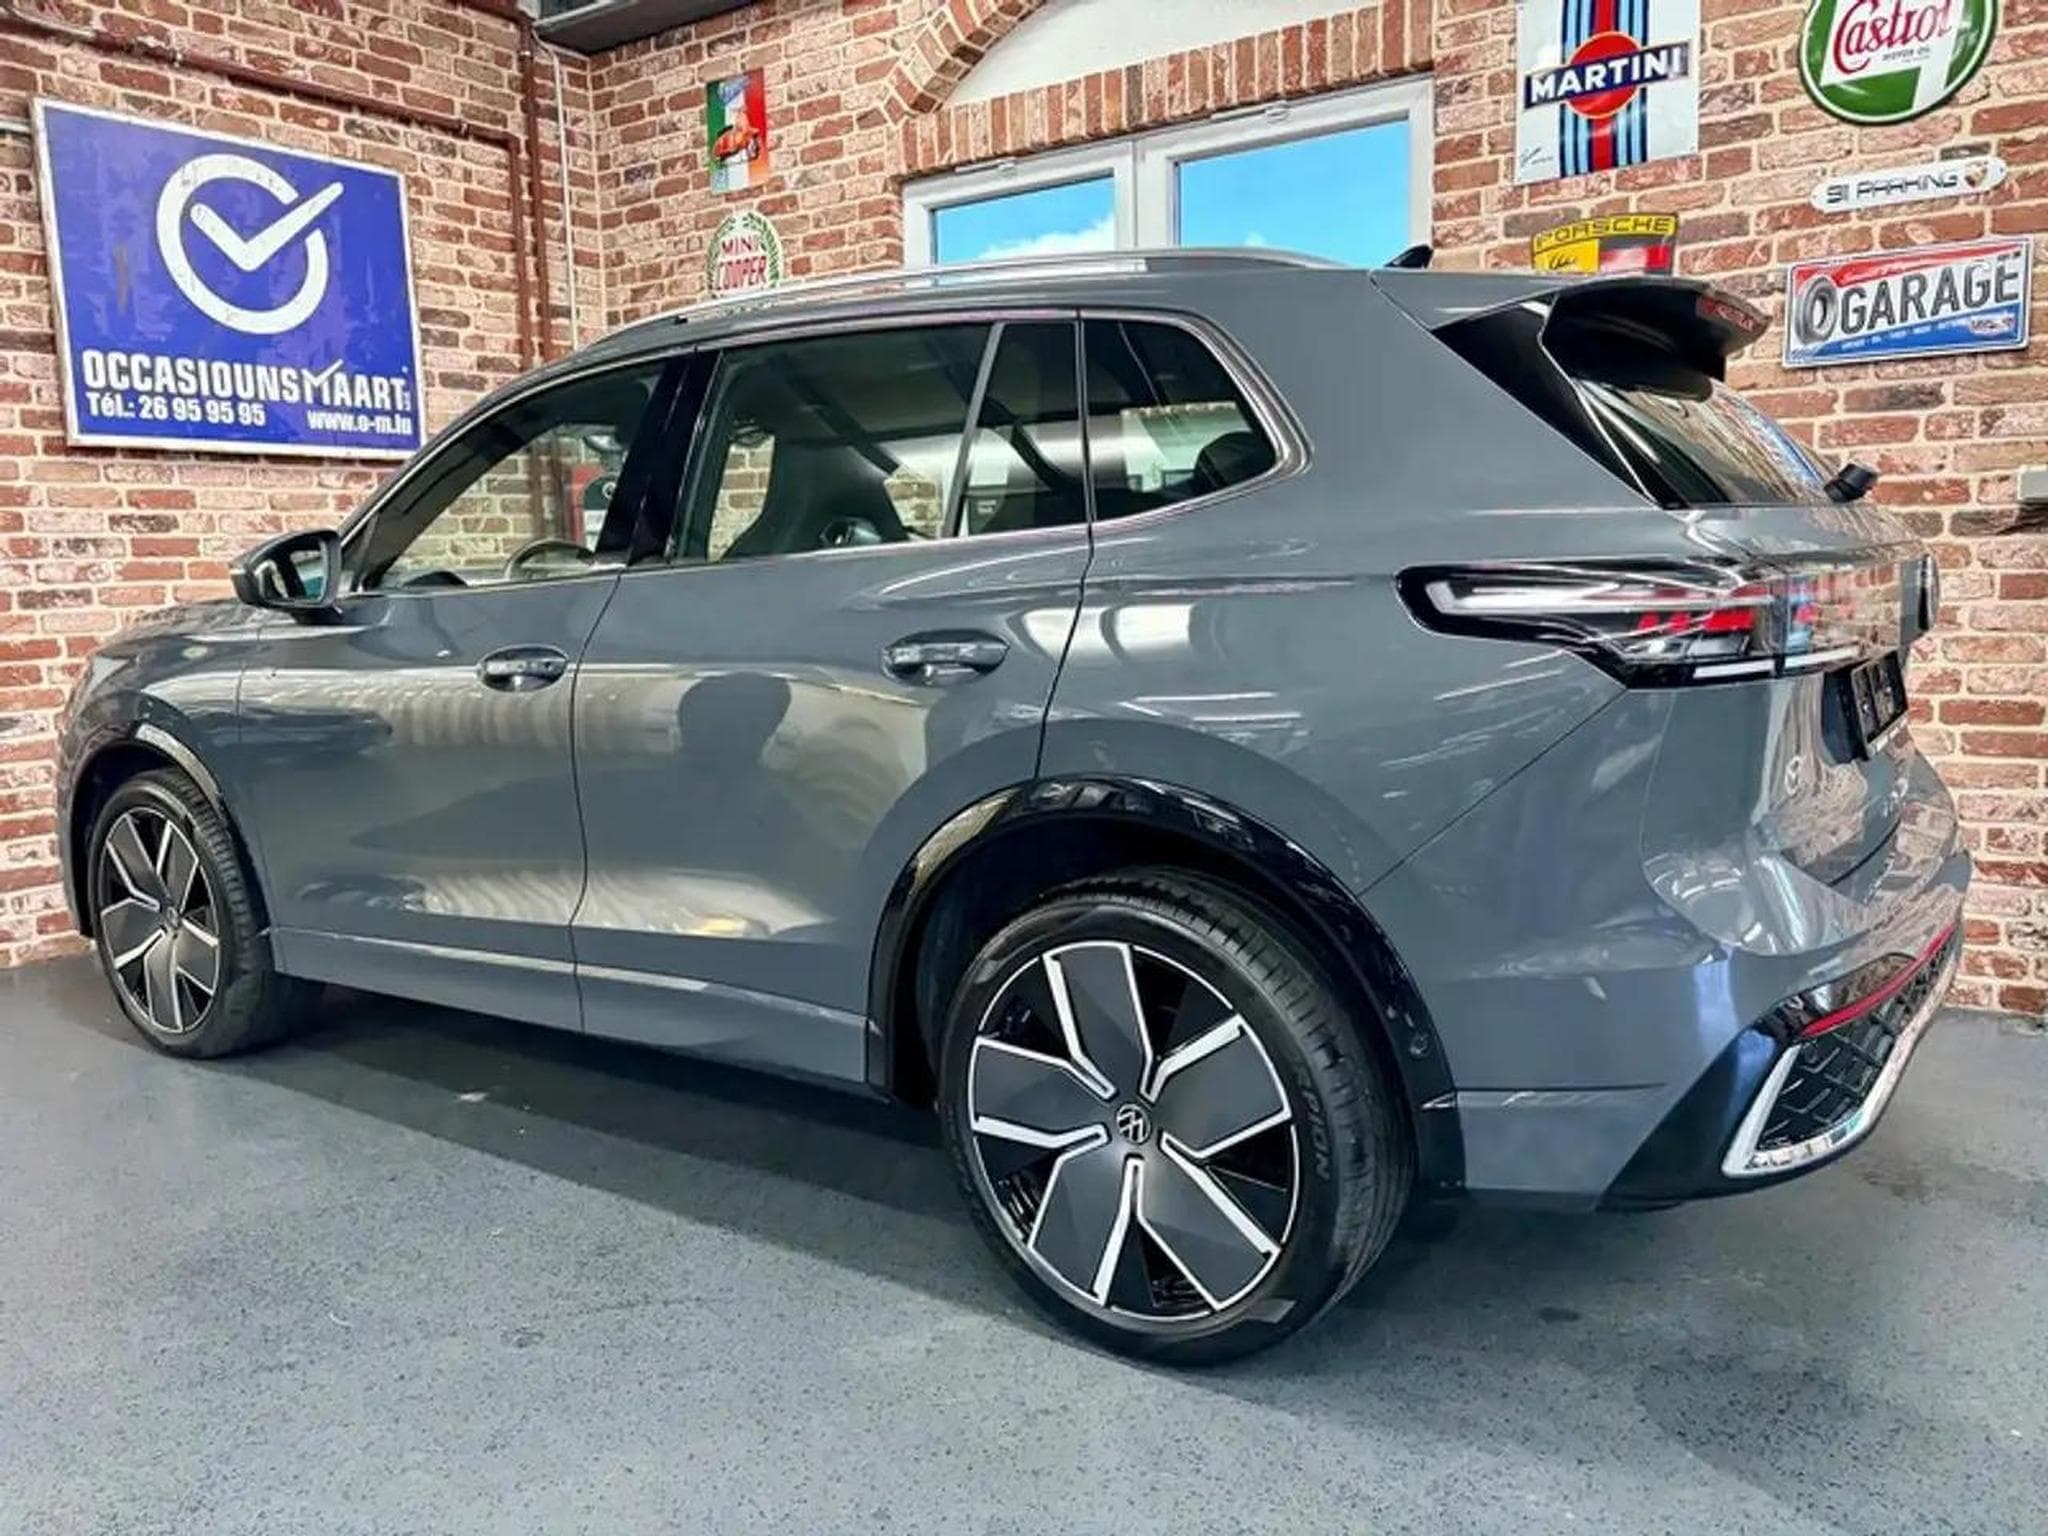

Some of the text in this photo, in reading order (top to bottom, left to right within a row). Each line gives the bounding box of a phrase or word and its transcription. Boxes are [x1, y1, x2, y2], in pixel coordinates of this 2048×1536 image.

[1833, 0, 1953, 75] Castrol
[1530, 47, 1682, 103] MARTINI
[1856, 174, 1959, 200] PARKING
[721, 235, 759, 254] MINI
[1536, 217, 1670, 248] PORSCHE
[715, 255, 768, 291] COOPER
[1840, 250, 2021, 334] GARAGE
[82, 349, 406, 411] OCCASIOUNSMAART
[138, 394, 169, 420] 26
[172, 396, 202, 422] 95
[205, 398, 235, 424] 95
[238, 401, 266, 427] 95
